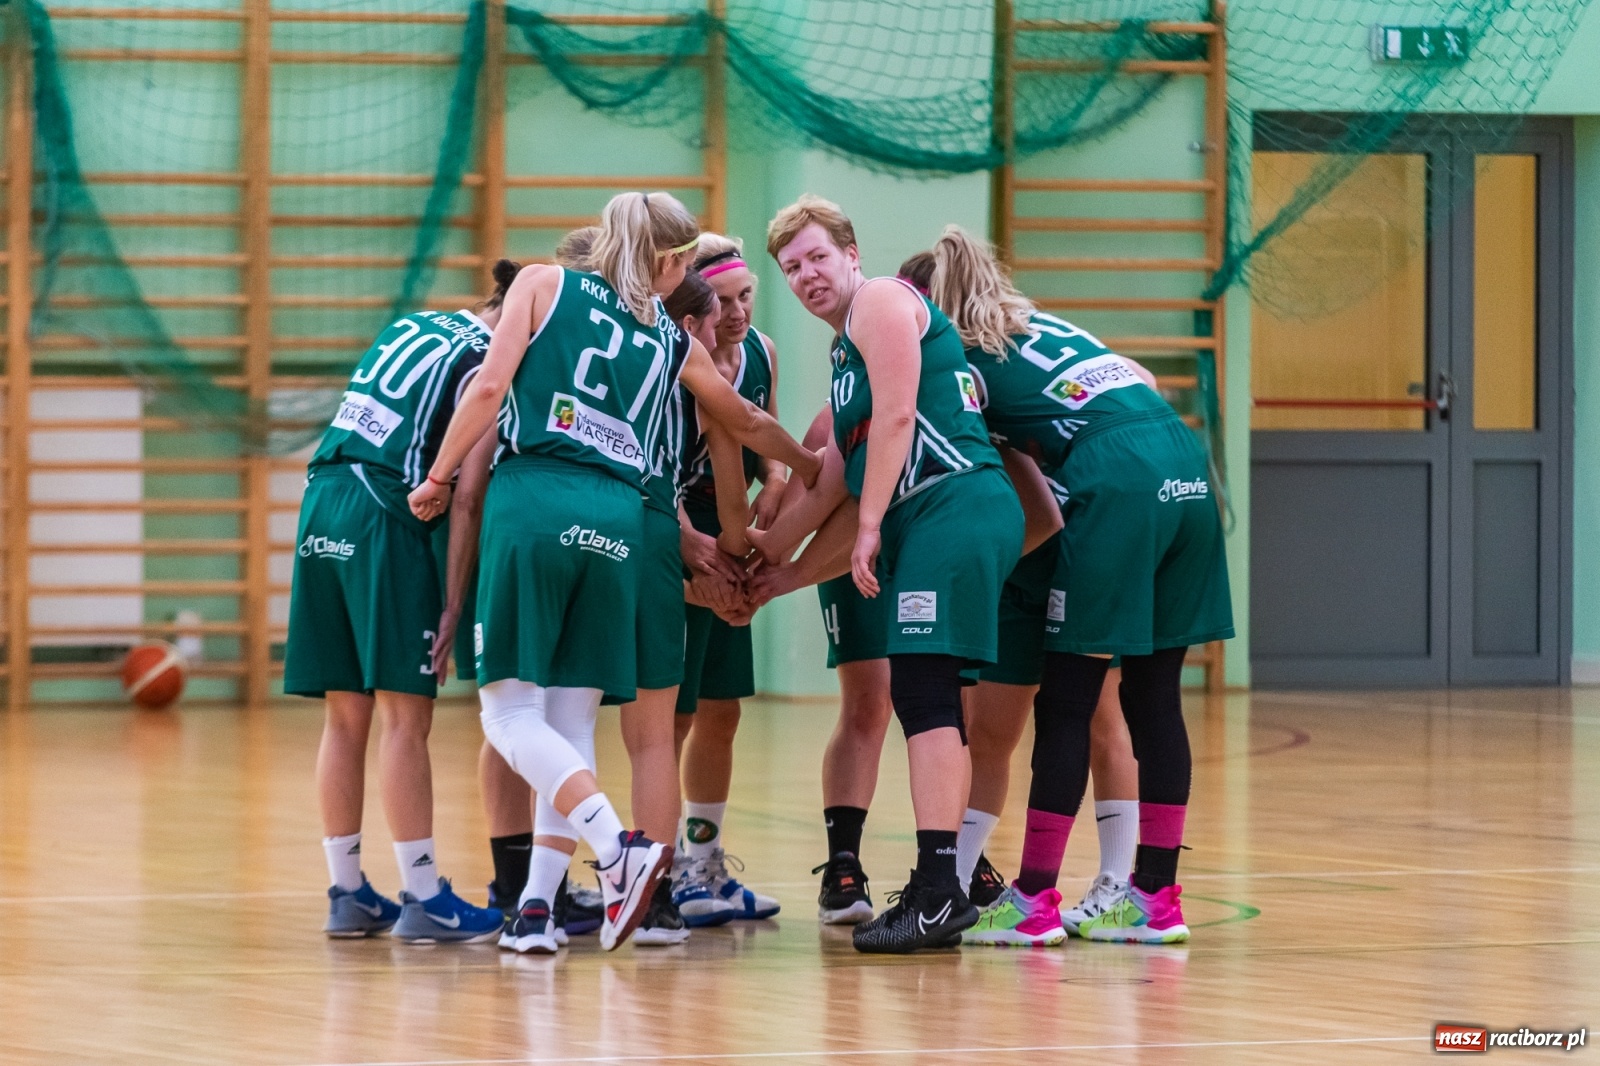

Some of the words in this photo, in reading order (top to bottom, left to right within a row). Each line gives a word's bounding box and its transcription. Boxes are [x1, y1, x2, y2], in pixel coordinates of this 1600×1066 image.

[581, 277, 610, 304] RKK
[351, 318, 452, 400] 30
[1020, 312, 1106, 372] 24
[574, 307, 666, 423] 27
[833, 370, 855, 414] 10
[1171, 476, 1208, 497] Clavis
[313, 536, 356, 556] Clavis
[577, 529, 630, 559] Clavis
[420, 629, 438, 675] 3
